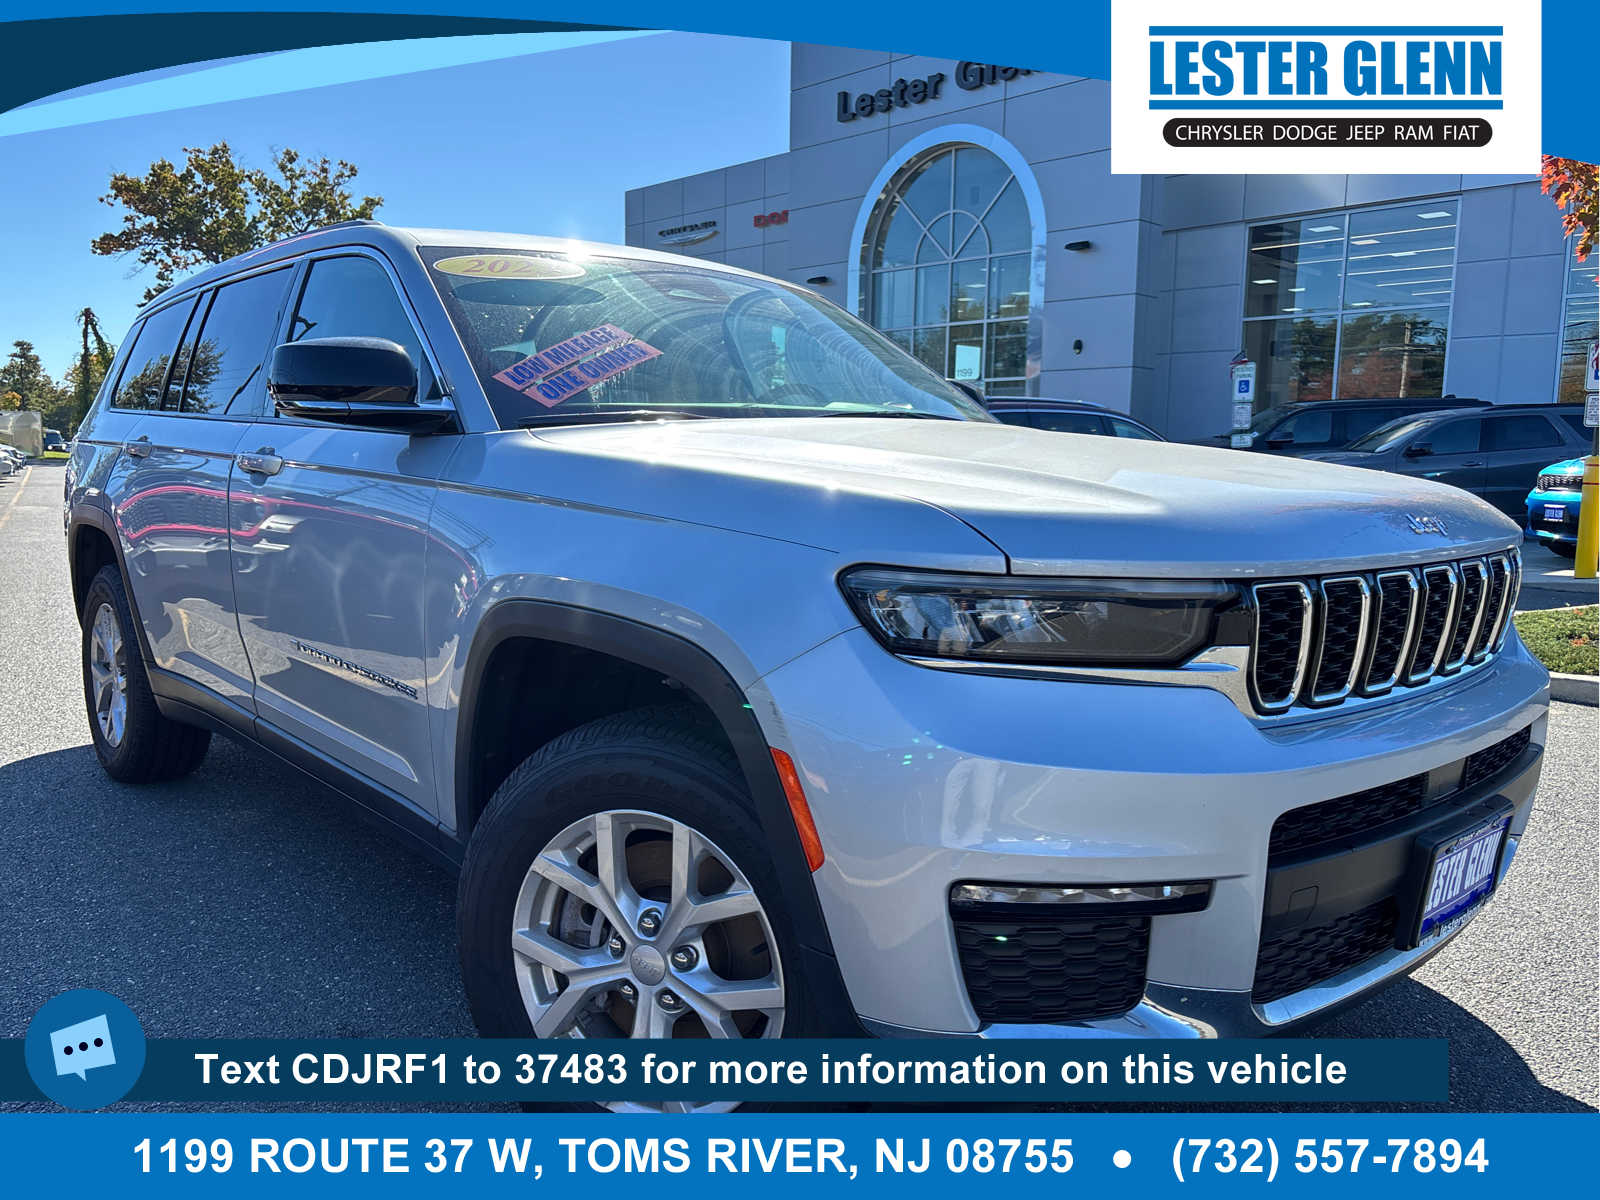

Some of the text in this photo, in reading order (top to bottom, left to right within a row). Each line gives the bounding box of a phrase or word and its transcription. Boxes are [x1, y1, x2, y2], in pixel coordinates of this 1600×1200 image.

[837, 72, 945, 122] Lester
[504, 326, 619, 385] LOW MILEAGE
[536, 343, 648, 400] ONE OWNER
[1464, 829, 1504, 890] GLENN
